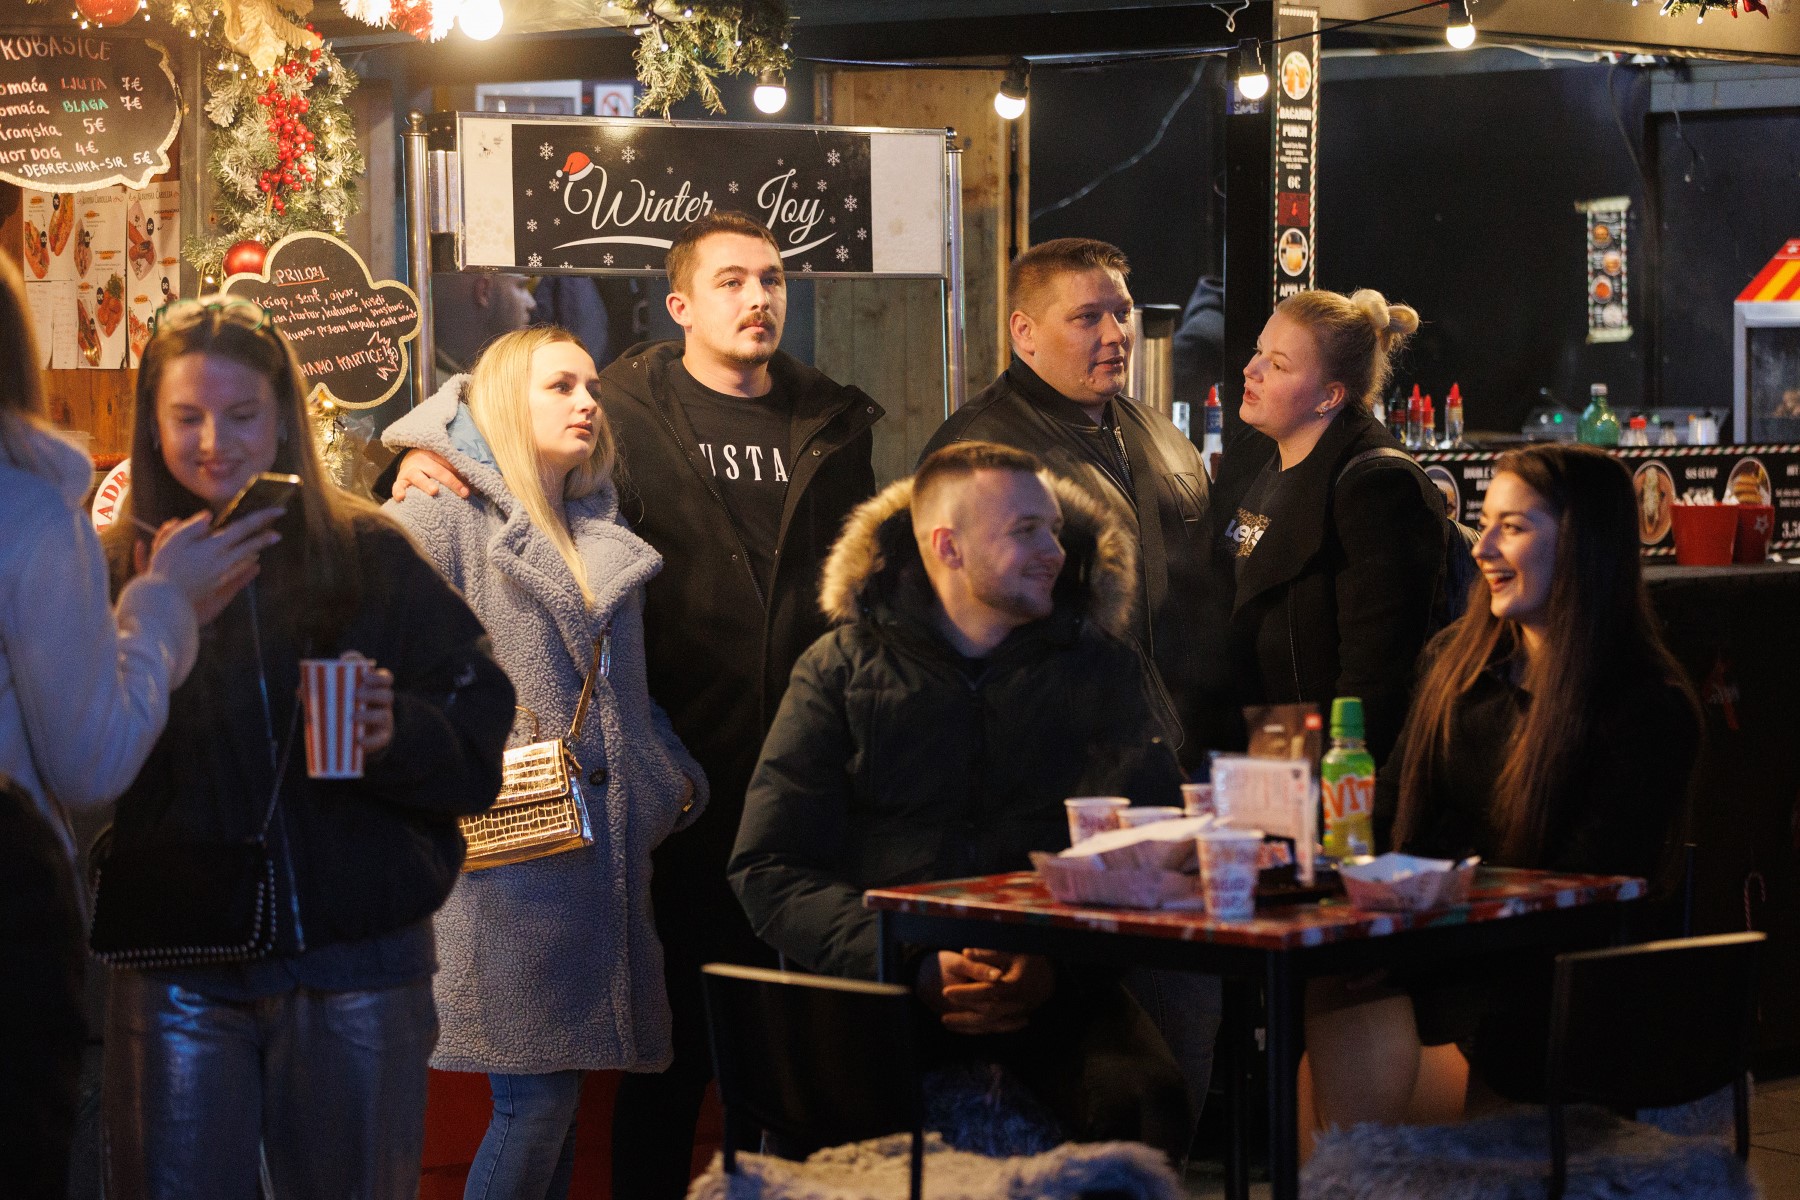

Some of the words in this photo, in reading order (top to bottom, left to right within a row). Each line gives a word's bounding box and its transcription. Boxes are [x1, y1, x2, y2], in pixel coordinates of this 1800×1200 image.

[0, 36, 112, 61] KOBASICE
[121, 76, 144, 92] 7€
[62, 98, 108, 113] BLAGA
[120, 95, 143, 111] 7€
[83, 117, 106, 135] 5€
[0, 149, 27, 164] HOT
[30, 147, 62, 160] DOG
[75, 140, 99, 156] 4€
[133, 150, 154, 165] 5€
[563, 165, 713, 230] Winter
[757, 168, 825, 243] Joy
[1321, 775, 1376, 819] VIT
